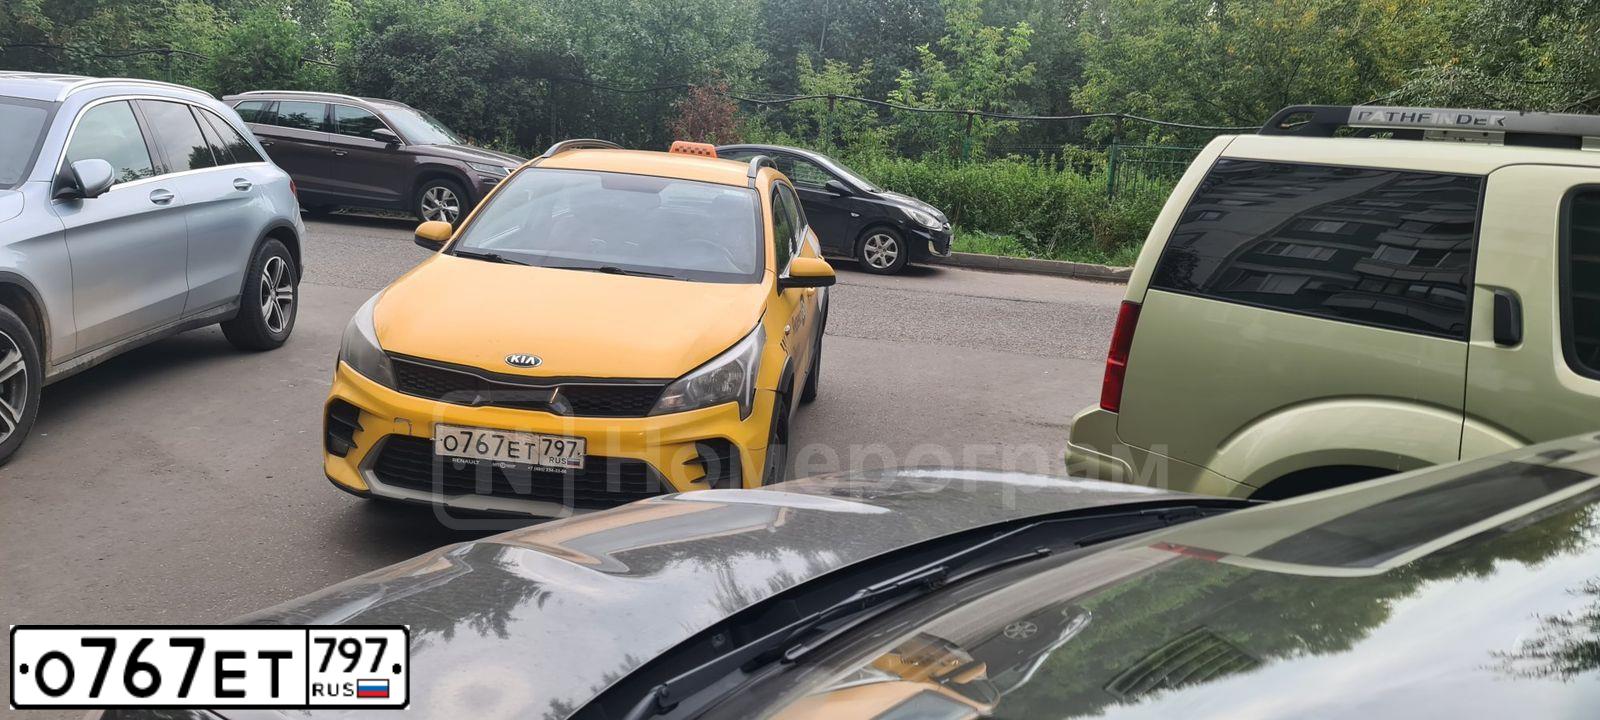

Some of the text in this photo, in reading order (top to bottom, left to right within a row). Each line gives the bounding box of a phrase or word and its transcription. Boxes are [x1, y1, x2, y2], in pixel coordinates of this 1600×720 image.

[1357, 110, 1507, 127] PATHFINDER
[510, 355, 536, 365] KIA
[542, 438, 577, 458] 797
[452, 457, 480, 465] RENAULT
[548, 456, 567, 465] RUS
